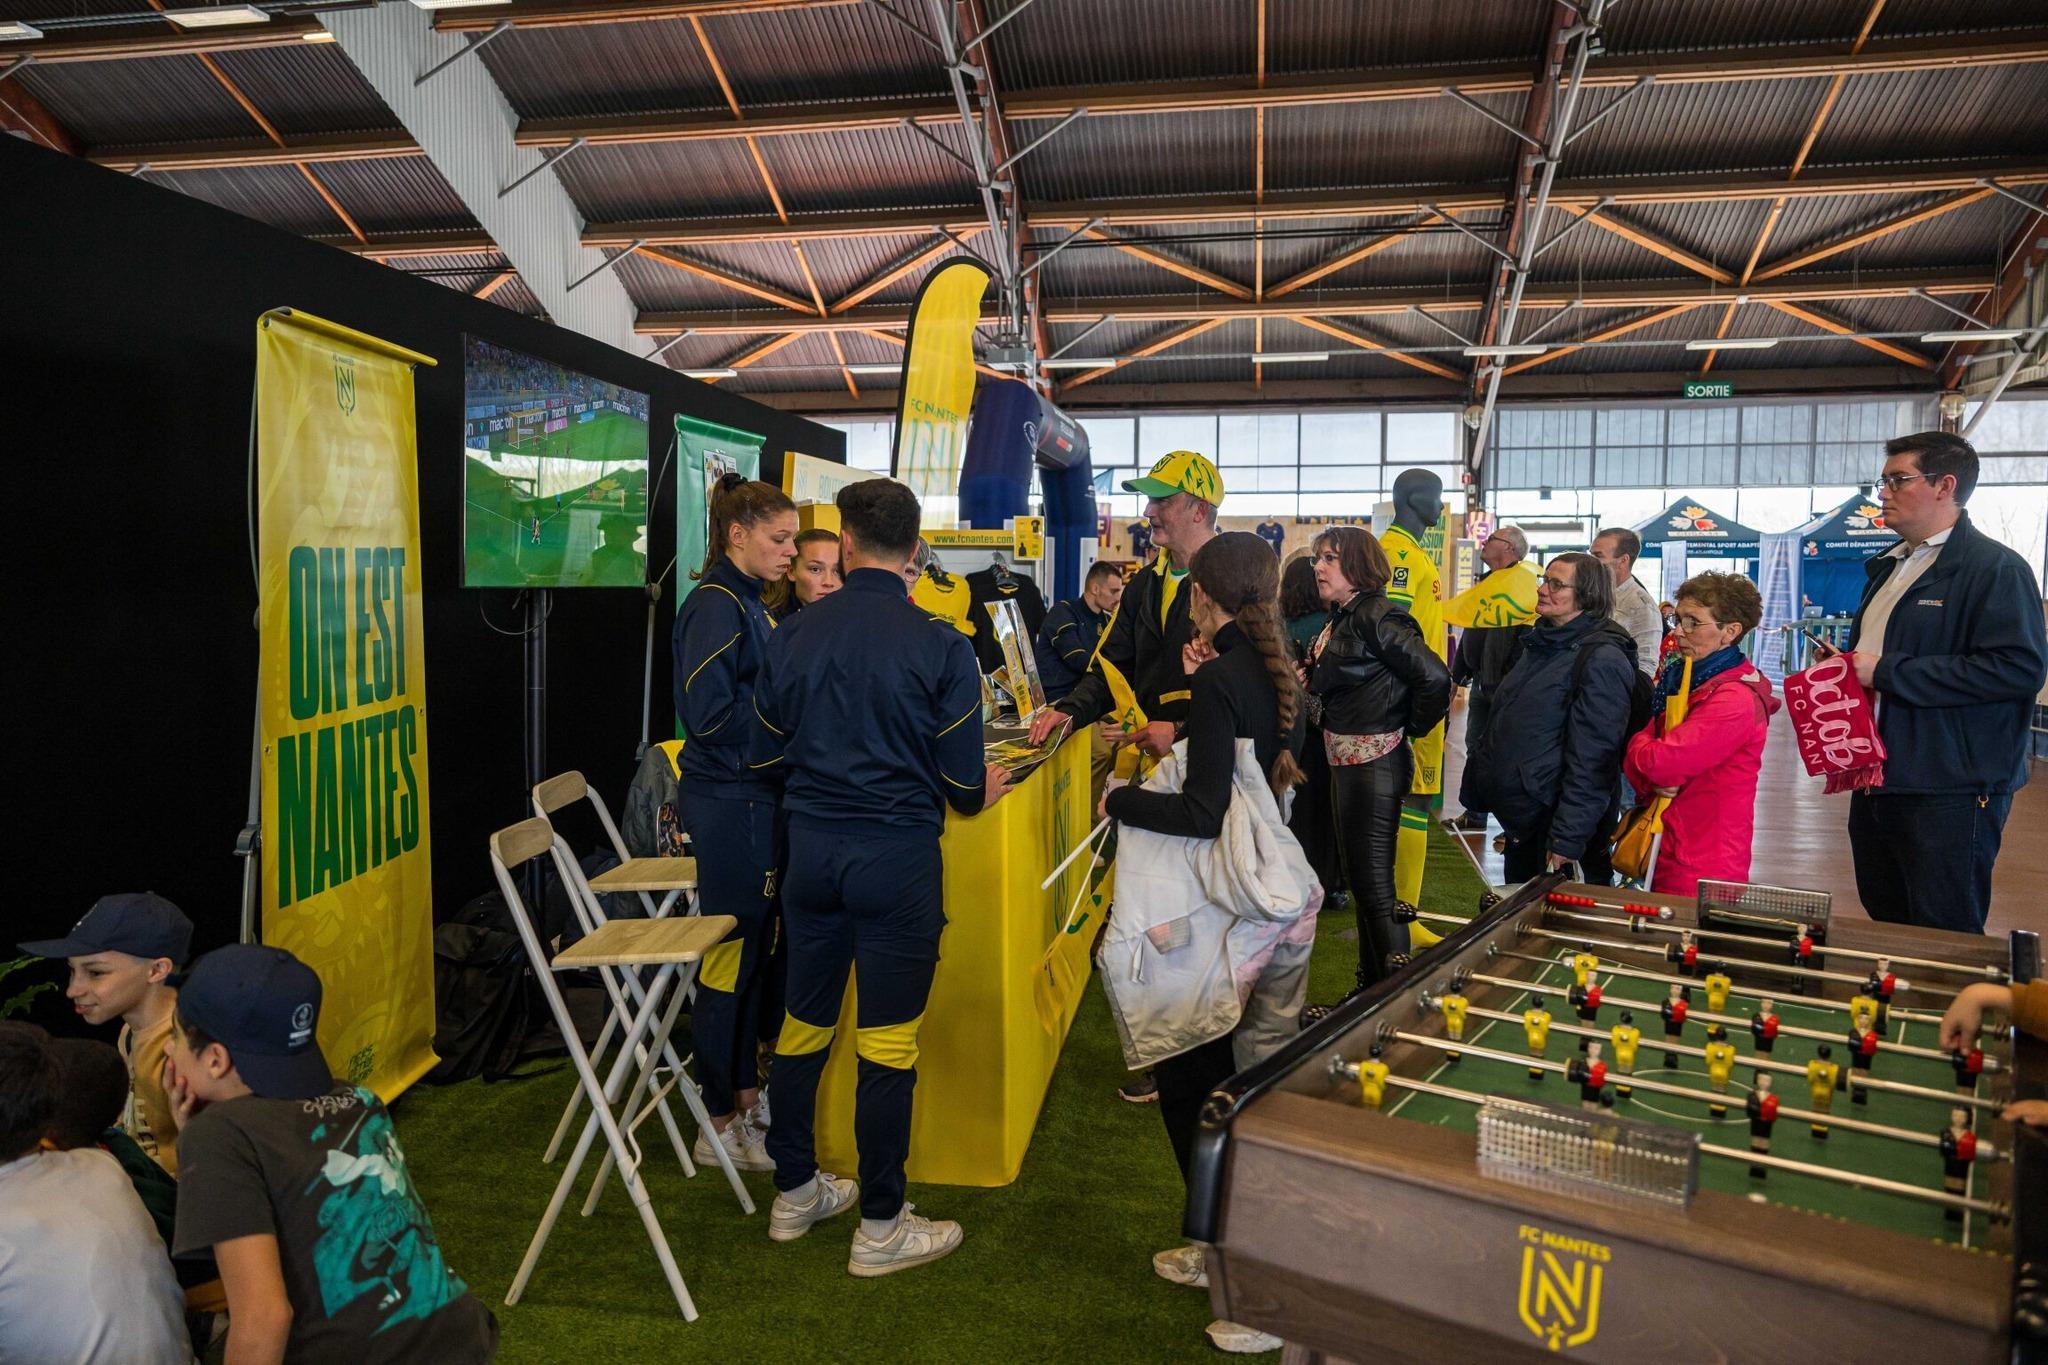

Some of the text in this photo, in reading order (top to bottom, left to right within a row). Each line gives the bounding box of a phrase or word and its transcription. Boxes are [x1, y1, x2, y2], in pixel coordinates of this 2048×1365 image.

[1687, 385, 1730, 398] SORTIE
[911, 399, 922, 412] FC
[933, 534, 1014, 544] www.fcnantes.com
[289, 546, 406, 721] ON EST
[1790, 685, 1807, 711] FC
[278, 704, 420, 910] NANTES
[1519, 1224, 1612, 1263] FC NANTES
